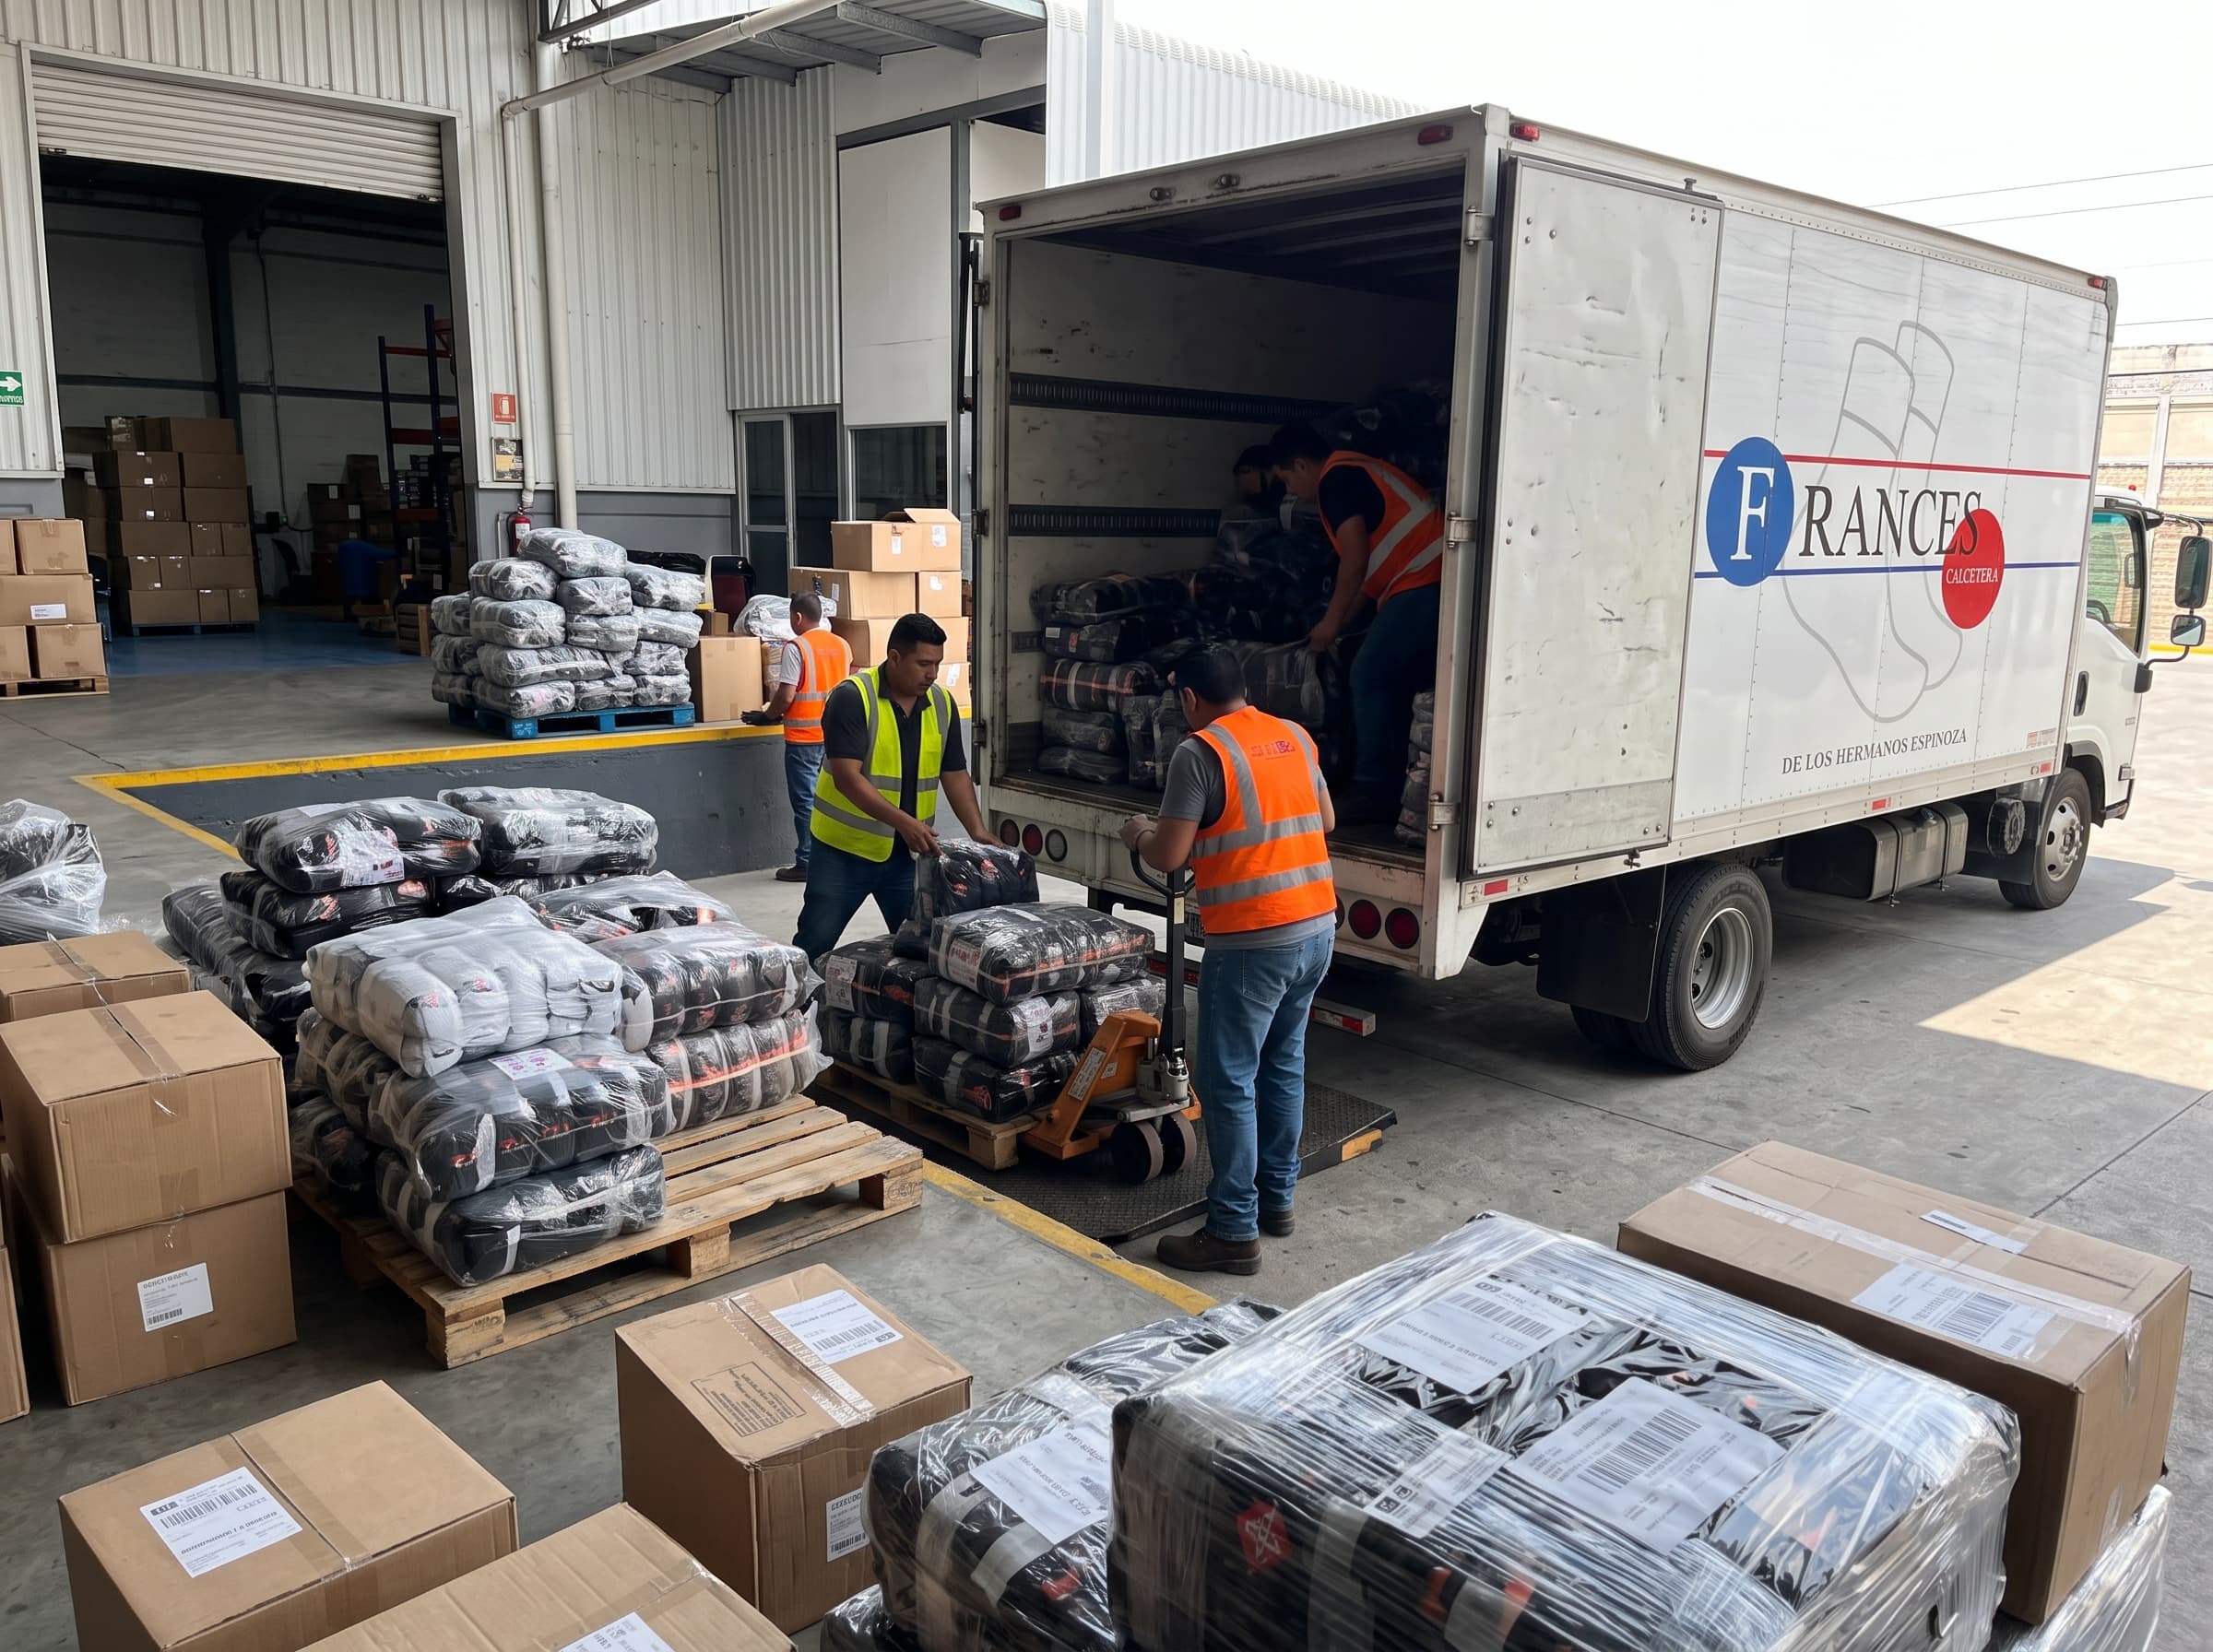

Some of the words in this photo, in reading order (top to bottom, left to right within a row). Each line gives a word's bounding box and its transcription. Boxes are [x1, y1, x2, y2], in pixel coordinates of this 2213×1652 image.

[1946, 568, 1998, 584] CALCETERA
[1781, 756, 1802, 774] DE
[1806, 751, 1832, 771] LOS
[1836, 738, 1908, 764] HERMANOS
[1910, 729, 1966, 751] ESPINOZA
